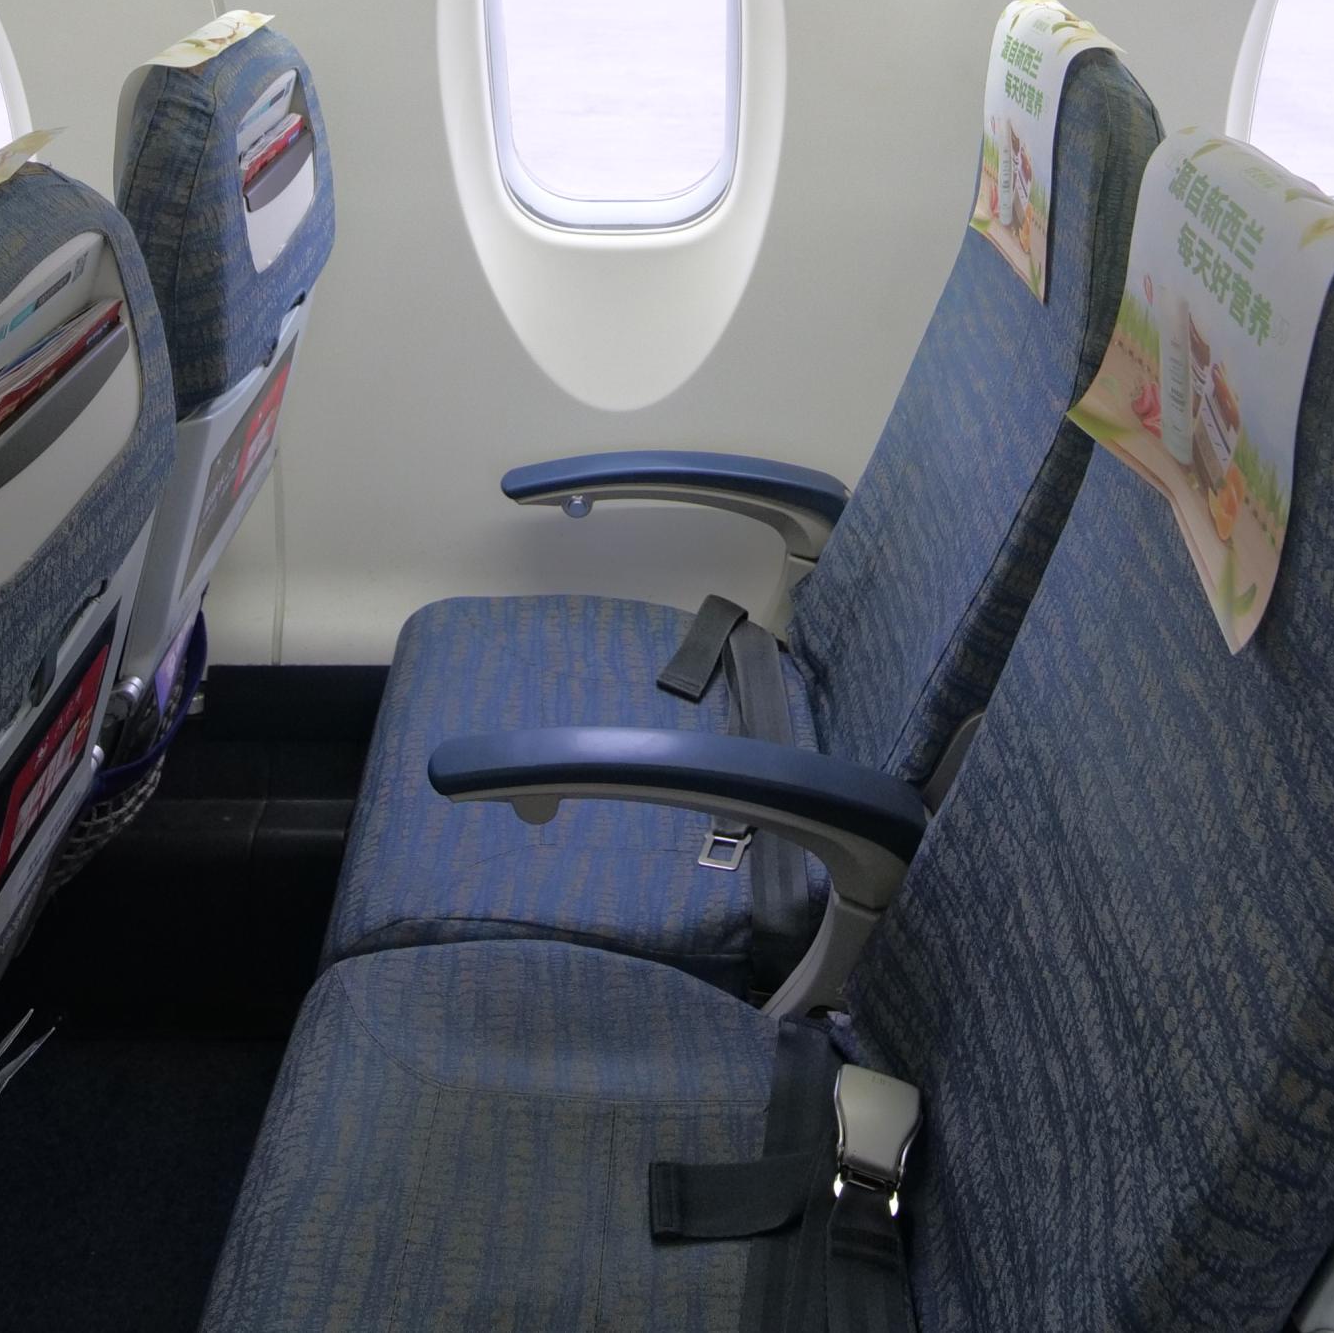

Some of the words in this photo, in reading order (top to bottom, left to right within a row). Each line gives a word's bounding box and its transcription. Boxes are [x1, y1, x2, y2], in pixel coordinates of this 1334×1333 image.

[1168, 158, 1267, 271] 源自新西兰
[1176, 221, 1273, 347] 每天好营养
